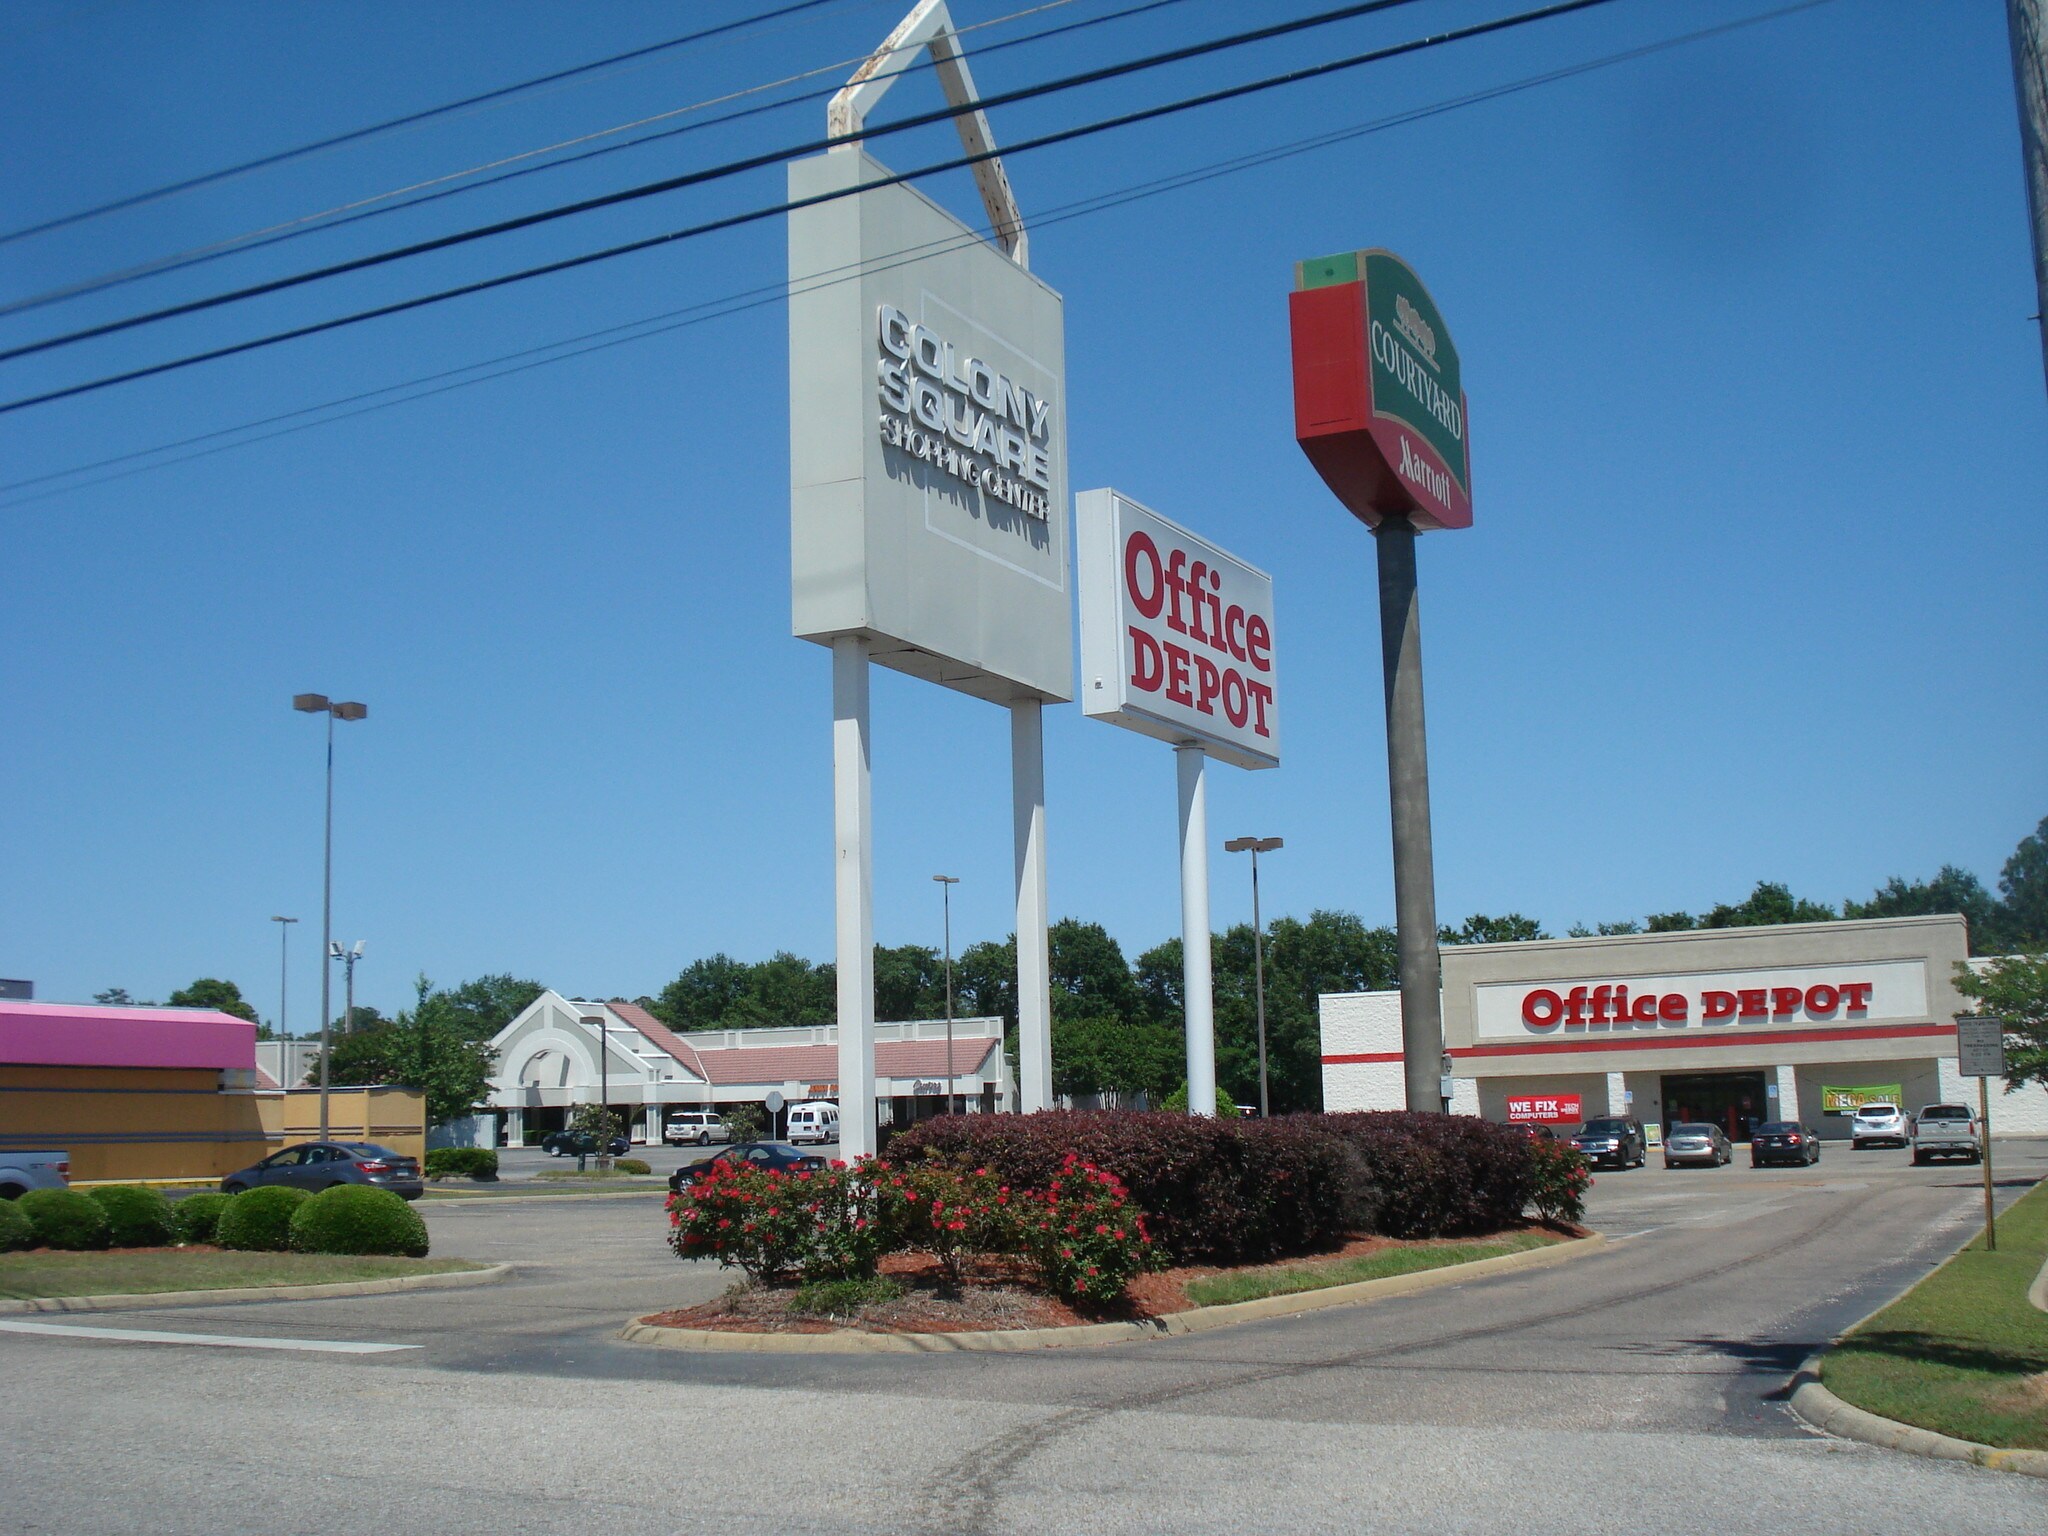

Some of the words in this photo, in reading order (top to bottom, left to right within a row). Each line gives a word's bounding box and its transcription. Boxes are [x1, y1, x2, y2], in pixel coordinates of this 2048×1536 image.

[877, 304, 1049, 438] COLONY
[877, 358, 1049, 490] SQUARE
[1371, 320, 1461, 440] COURTYARD
[879, 414, 981, 488] SHOPPING
[980, 467, 1050, 522] CENTER
[1399, 435, 1452, 510] Marriott
[1125, 530, 1271, 672] Office
[1128, 625, 1273, 738] DEPOT
[1521, 984, 1689, 1029] Office
[1701, 982, 1873, 1023] DEPOT
[1509, 1102, 1532, 1113] WE
[1535, 1100, 1558, 1112] FIX
[1509, 1111, 1559, 1120] COMPUTERS
[1825, 1093, 1865, 1107] MEGA
